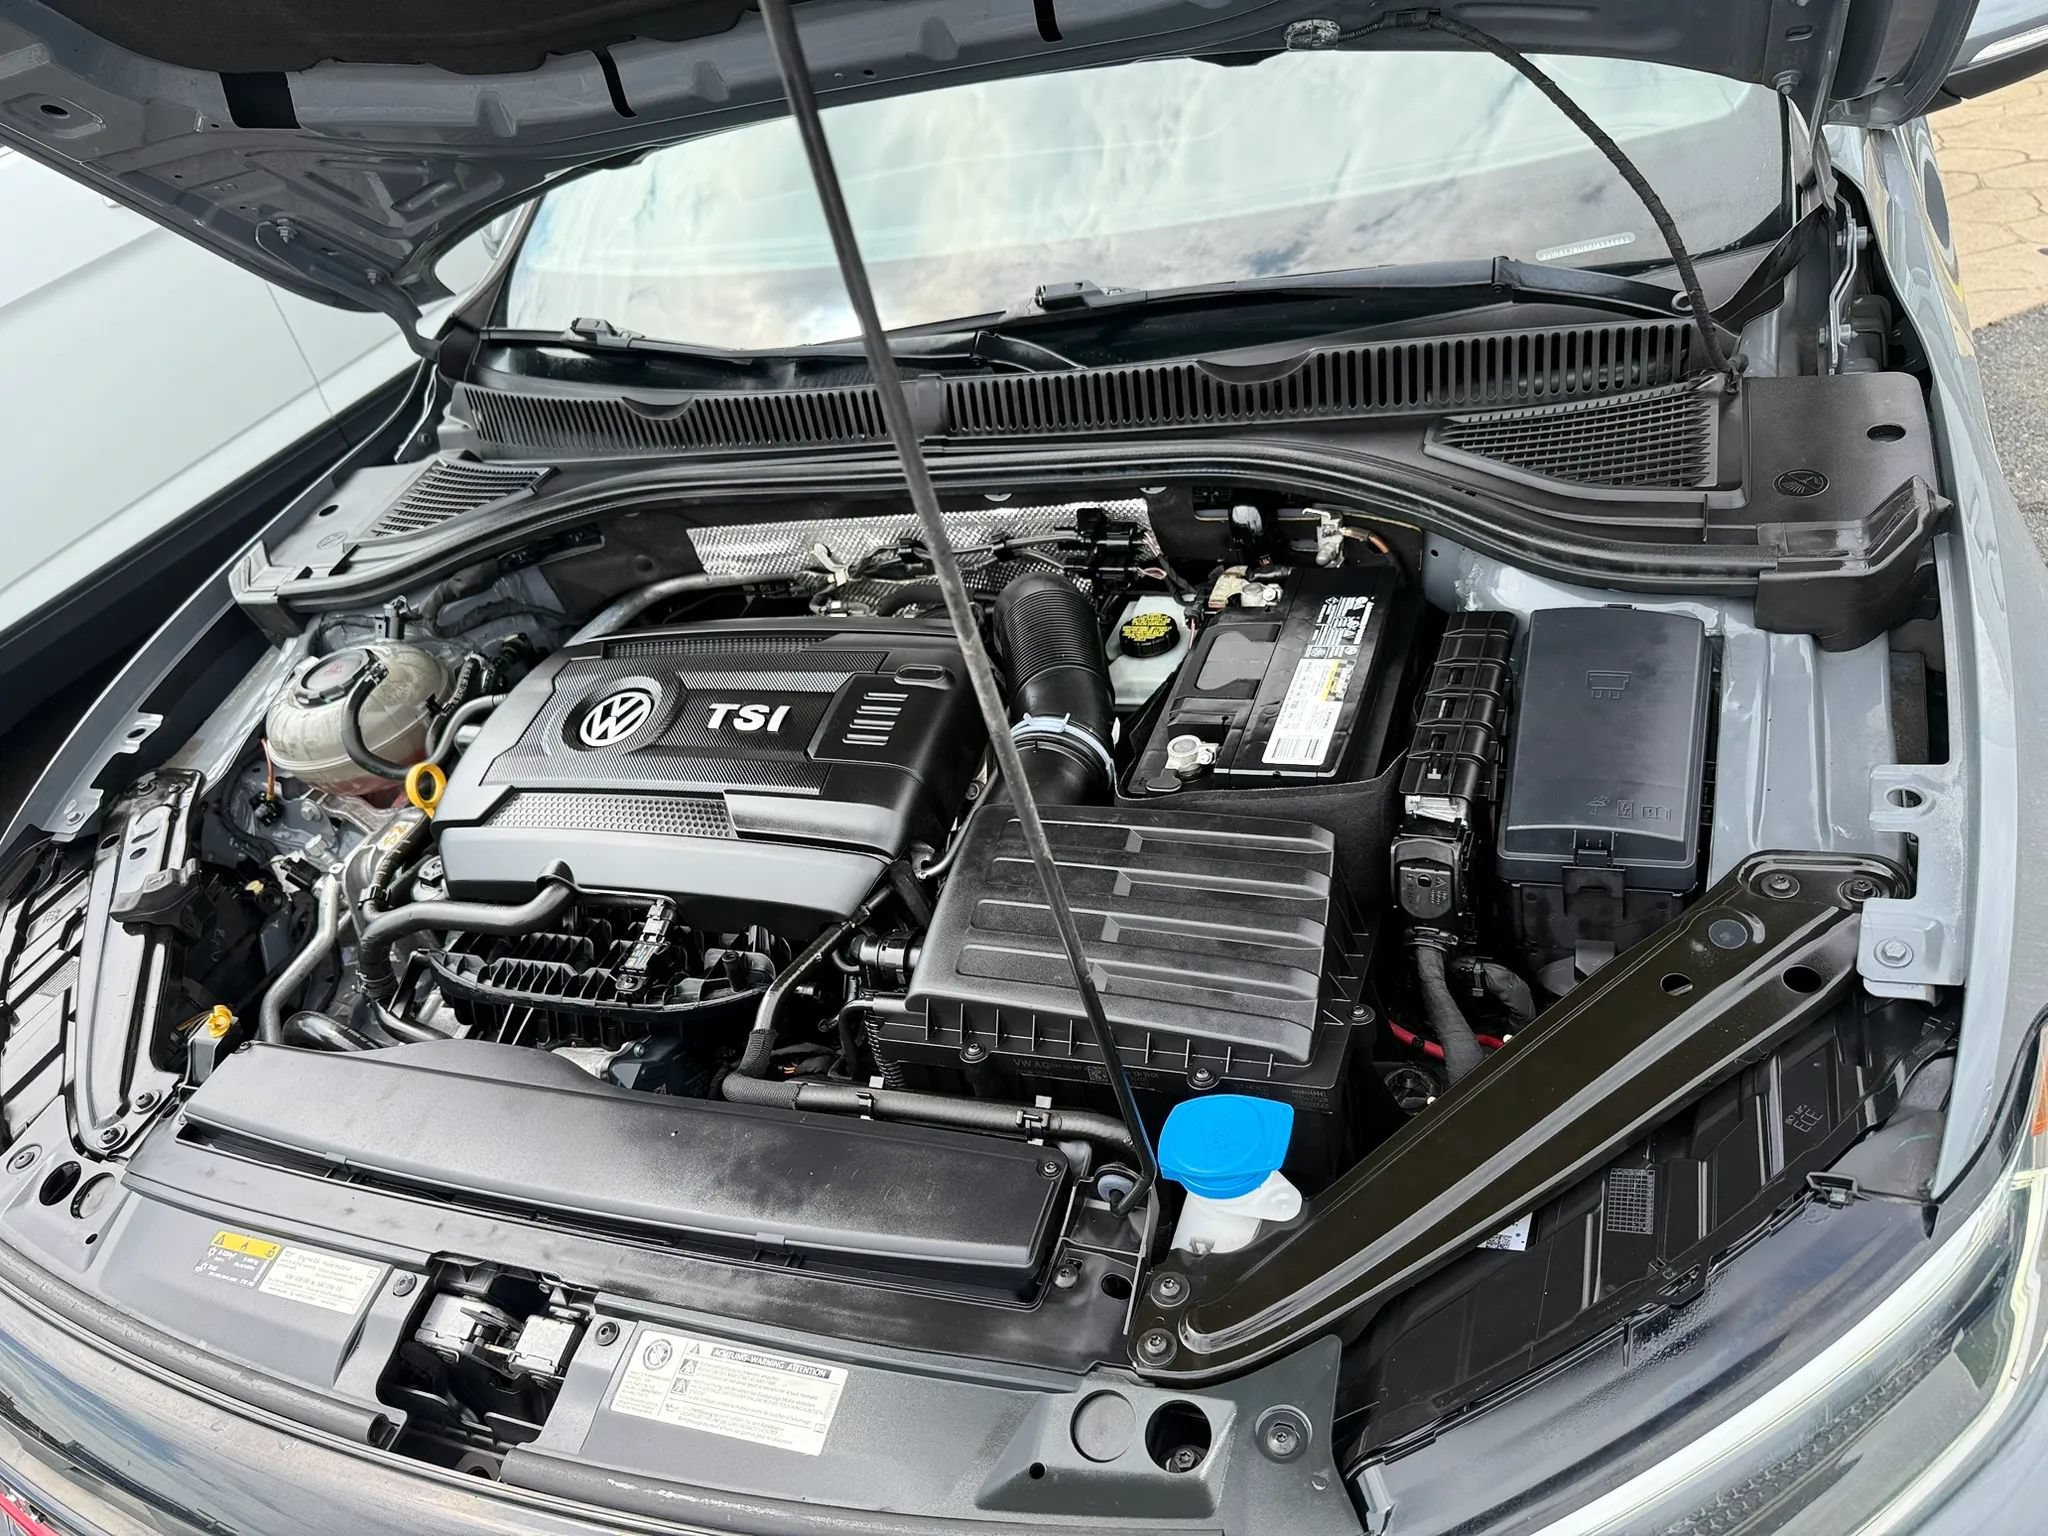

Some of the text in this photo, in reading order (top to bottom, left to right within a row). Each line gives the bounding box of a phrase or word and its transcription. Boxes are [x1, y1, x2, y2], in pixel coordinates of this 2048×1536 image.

[706, 703, 792, 732] TSI
[1012, 1057, 1032, 1068] VW
[786, 1361, 827, 1378] ATTENTION
